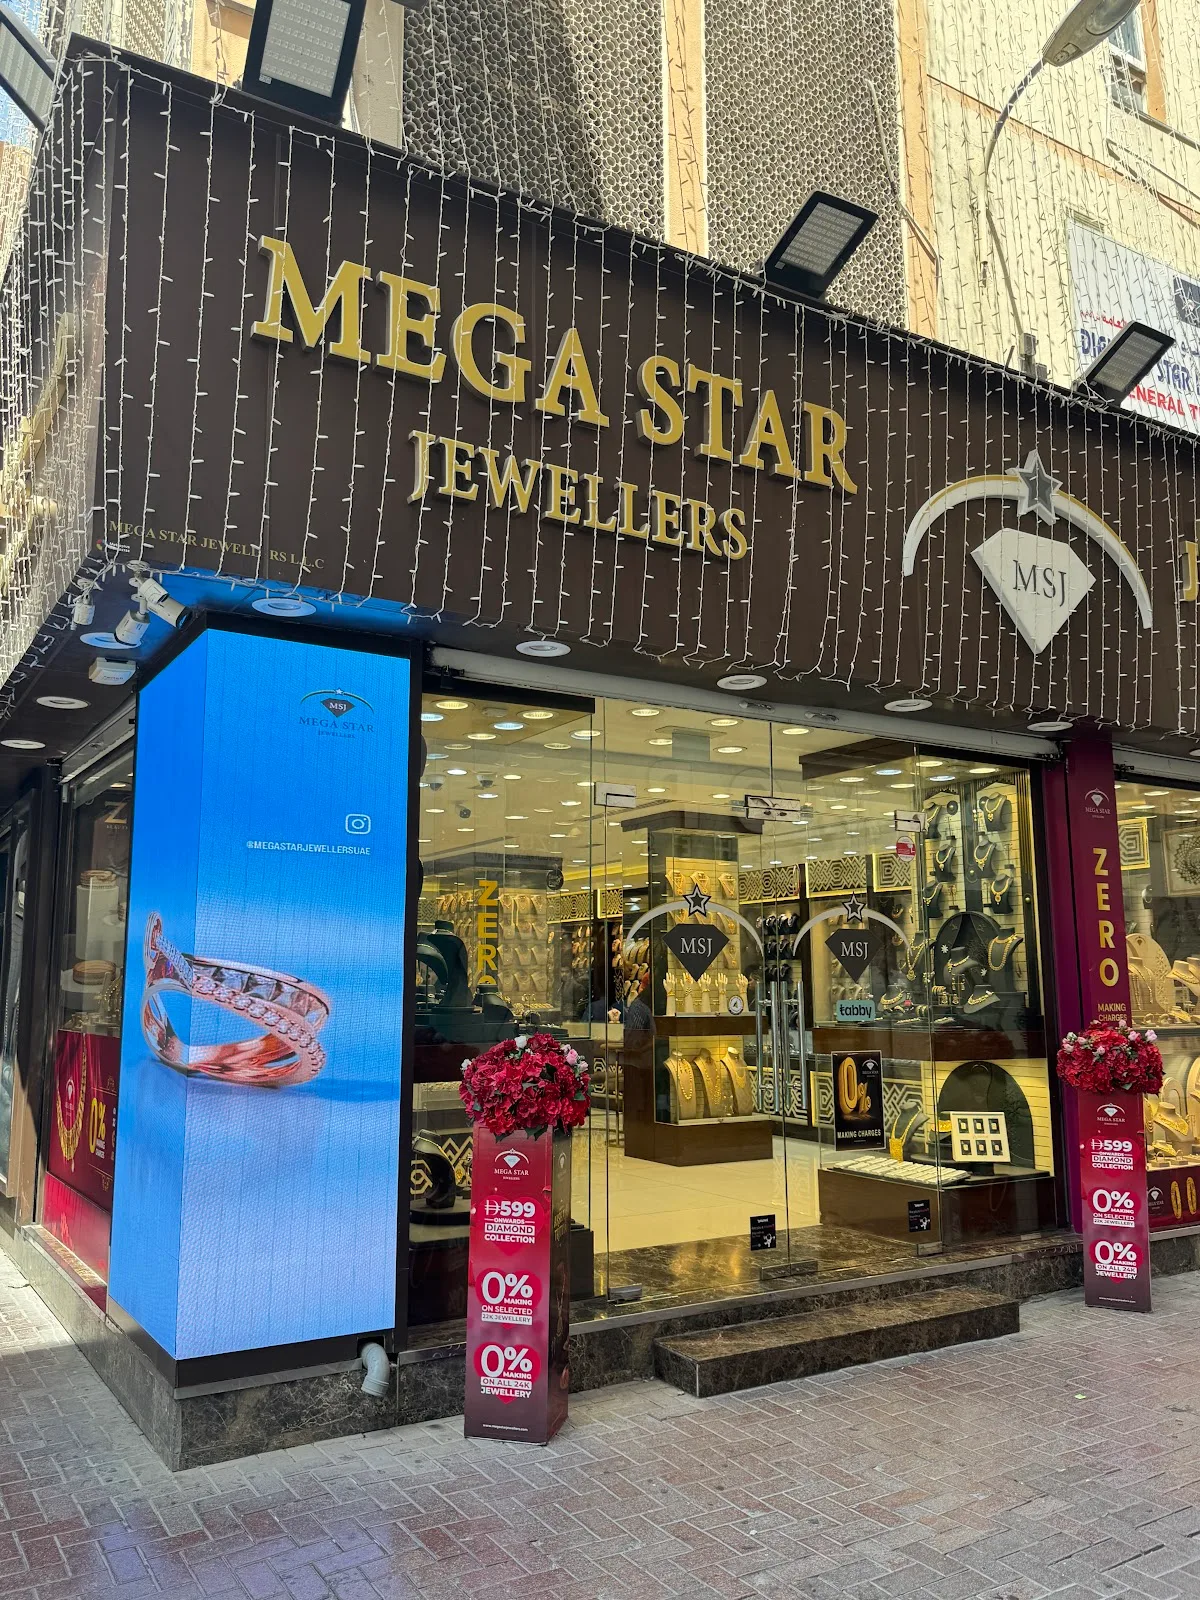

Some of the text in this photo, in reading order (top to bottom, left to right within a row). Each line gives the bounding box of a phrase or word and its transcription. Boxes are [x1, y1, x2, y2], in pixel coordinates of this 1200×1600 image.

[250, 236, 859, 495] MEGA STAR
[407, 430, 747, 562] JEWELLERS
[159, 530, 198, 547] STAR
[1013, 559, 1067, 607] MSJ
[329, 702, 347, 711] MSJ
[299, 716, 374, 733] MEGA STAR
[1093, 848, 1119, 987] ZERO
[680, 937, 713, 958] MSJ
[841, 941, 869, 960] MSJ
[839, 1003, 873, 1019] tabby
[1097, 1003, 1127, 1012] MAKING
[838, 1056, 871, 1114] 0%
[837, 1128, 882, 1139] MAKING CHARGES
[1093, 1155, 1132, 1164] DIAMOND
[1092, 1162, 1134, 1170] COLLECTION
[494, 1168, 512, 1176] MEGA
[1092, 1189, 1135, 1213] 0%
[493, 1217, 525, 1225] ONWARDS
[1104, 1213, 1135, 1221] SELECTED
[486, 1224, 533, 1234] DIAMOND
[484, 1233, 535, 1244] COLLECTION
[1095, 1241, 1137, 1265] 0%
[1096, 1271, 1137, 1280] JEWELLERY
[482, 1271, 533, 1305] 0%
[504, 1298, 533, 1306] MAKING
[482, 1305, 533, 1315] ON SELECTED
[494, 1314, 531, 1323] JEWELLERY
[481, 1344, 533, 1378] 0%
[503, 1371, 532, 1380] MAKING
[497, 1379, 511, 1387] ALL
[514, 1380, 531, 1389] 24K
[481, 1386, 532, 1399] JEWELLERY
